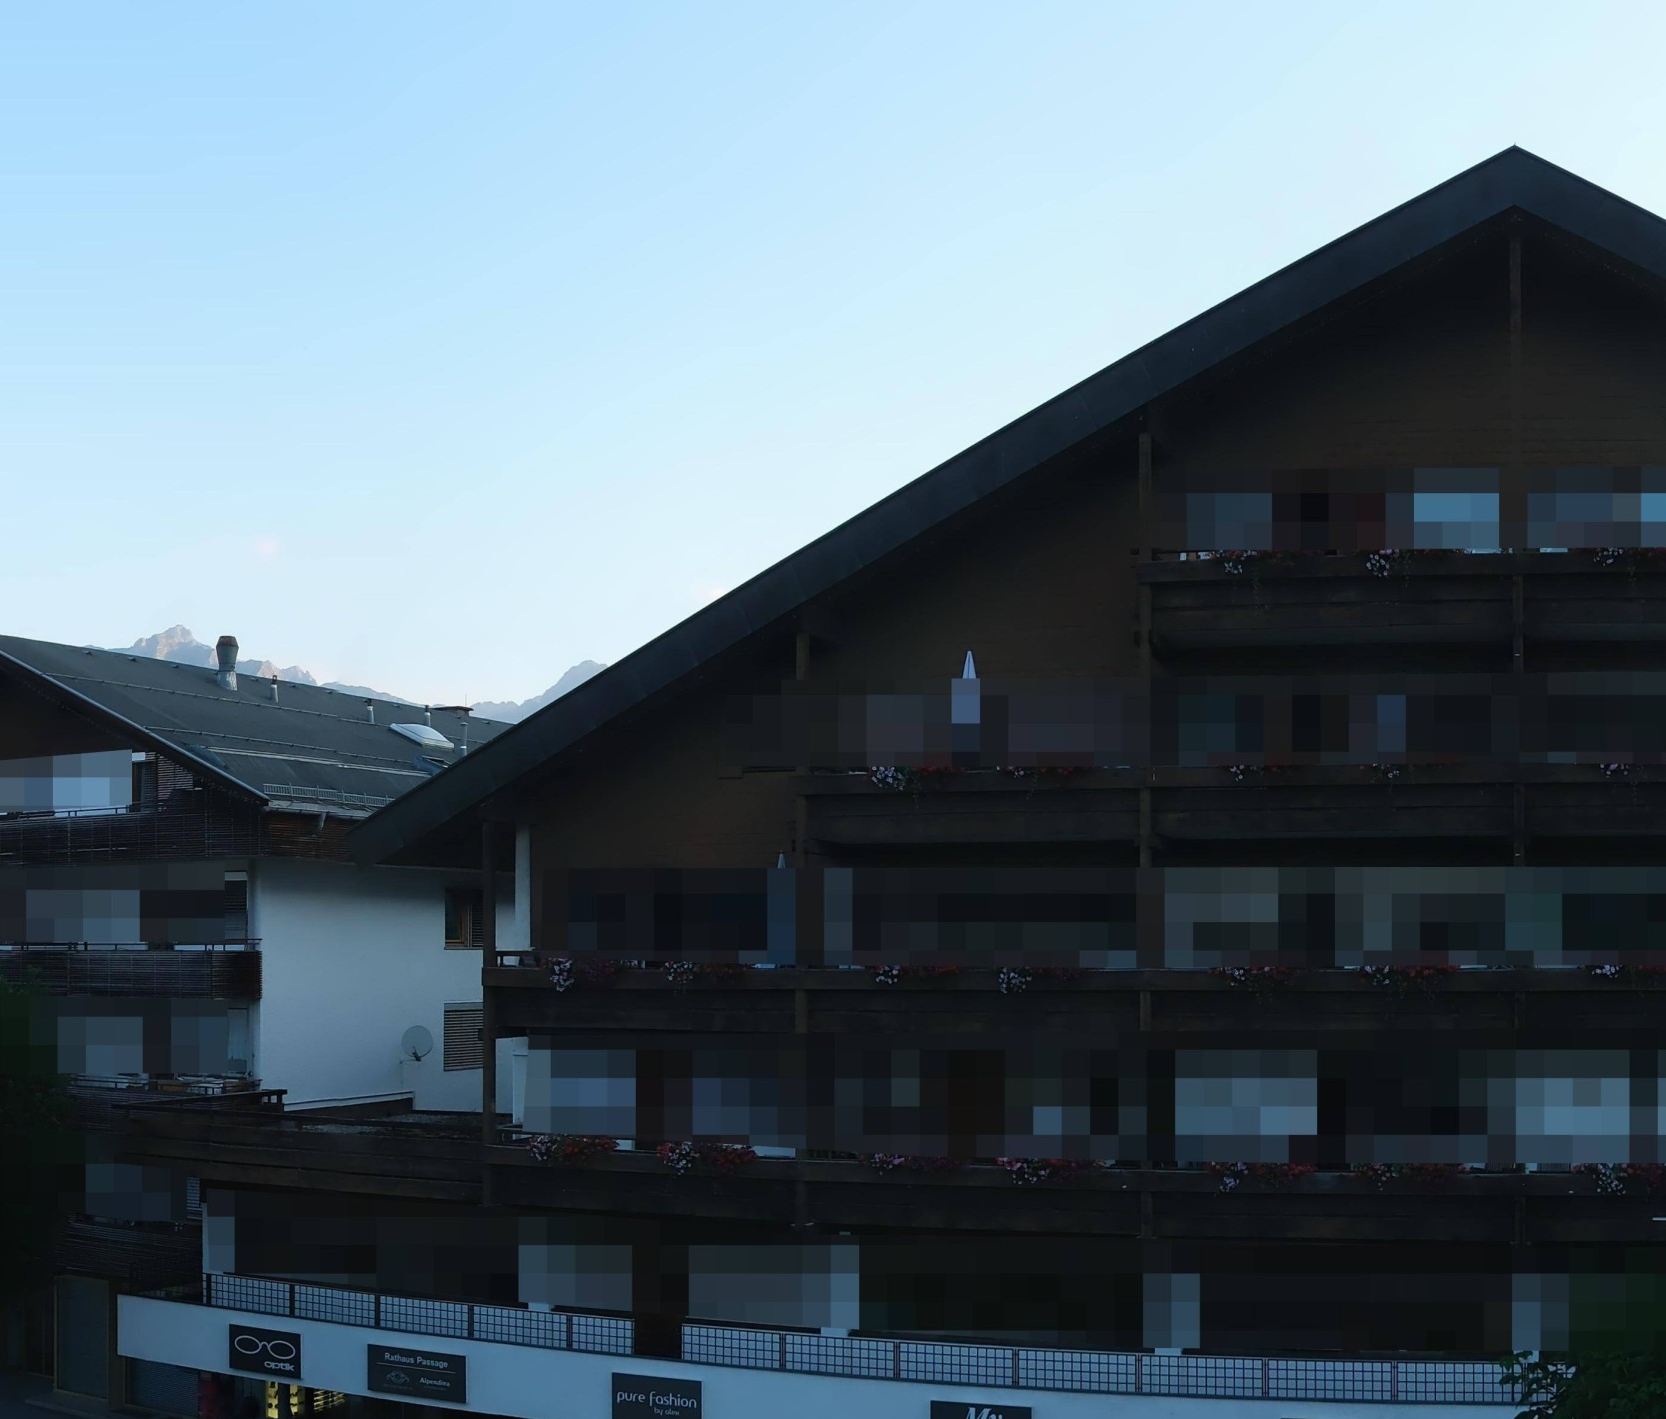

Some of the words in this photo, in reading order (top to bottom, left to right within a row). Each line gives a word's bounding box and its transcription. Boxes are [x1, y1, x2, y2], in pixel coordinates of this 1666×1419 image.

[264, 1360, 294, 1372] optik
[384, 1352, 414, 1365] Rathaus
[416, 1356, 448, 1370] Passage
[616, 1391, 646, 1404] pure
[649, 1391, 698, 1409] fashion
[654, 1407, 663, 1416] by
